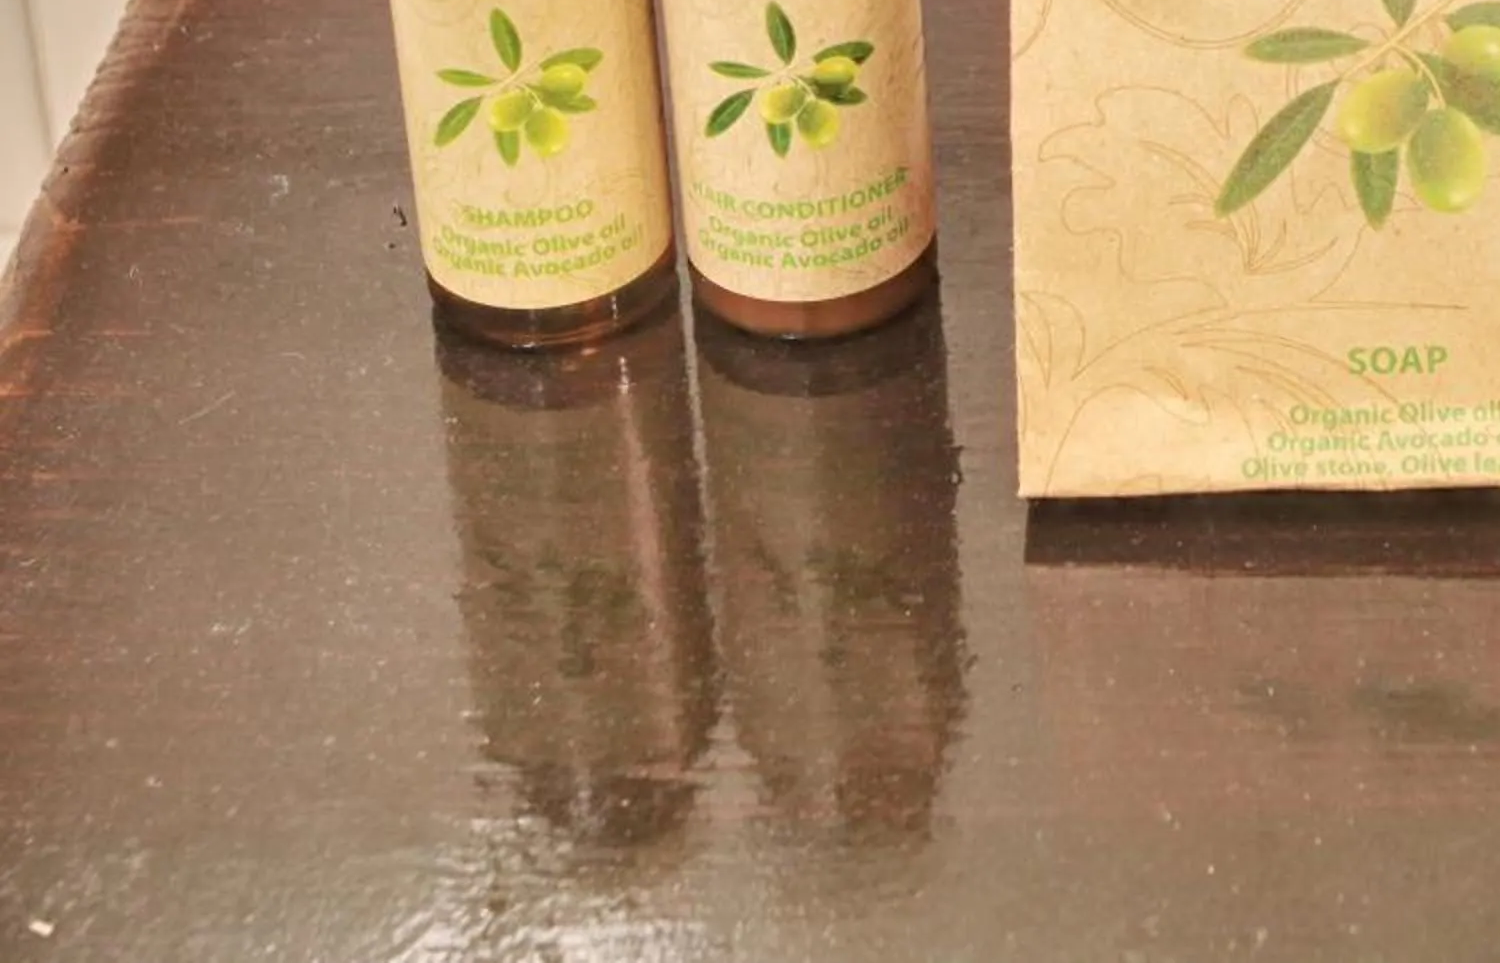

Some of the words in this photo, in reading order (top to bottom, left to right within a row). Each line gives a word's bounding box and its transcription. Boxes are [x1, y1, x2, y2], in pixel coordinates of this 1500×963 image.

[693, 182, 737, 212] HAIR
[742, 166, 908, 219] CONDITIONER
[462, 199, 593, 228] SHAMPOO
[709, 215, 794, 247] Organic
[800, 223, 863, 248] Olive
[867, 205, 892, 231] oil
[441, 224, 526, 256] Organic
[532, 232, 595, 256] Olive
[600, 213, 626, 238] oil
[514, 245, 615, 278] Avocado
[622, 224, 643, 250] oil
[699, 229, 773, 268] Organic
[781, 238, 882, 269] Avocado
[886, 217, 910, 241] oil
[1347, 345, 1449, 375] SOAP
[1289, 403, 1392, 431] Organic
[1399, 401, 1467, 424] Olive
[1268, 431, 1371, 456] Organic
[1377, 430, 1490, 452] Avocado
[1241, 455, 1309, 481] Olive
[1315, 456, 1394, 479] stone,
[1401, 454, 1469, 475] Olive
